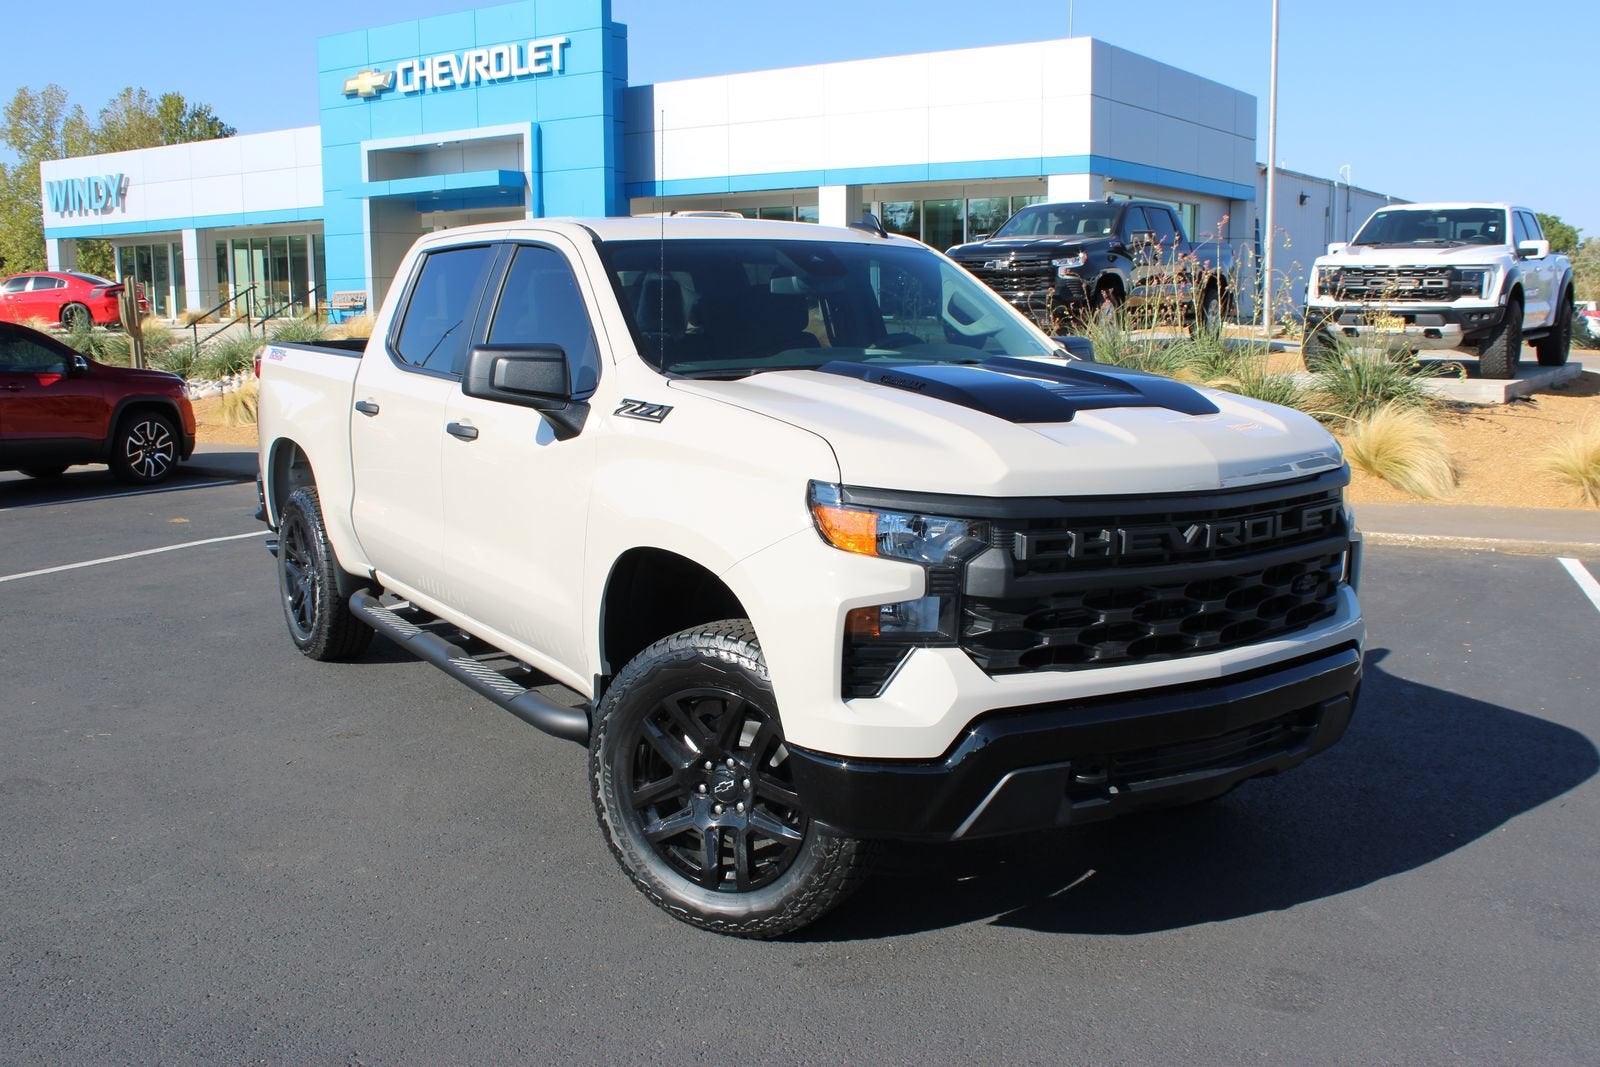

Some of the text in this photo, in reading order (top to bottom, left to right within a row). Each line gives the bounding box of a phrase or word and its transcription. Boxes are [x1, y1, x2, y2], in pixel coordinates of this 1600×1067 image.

[397, 36, 568, 93] CHEVROLET
[46, 173, 124, 213] WINDY
[613, 398, 675, 423] Z71
[1014, 503, 1341, 561] CHEVROLET
